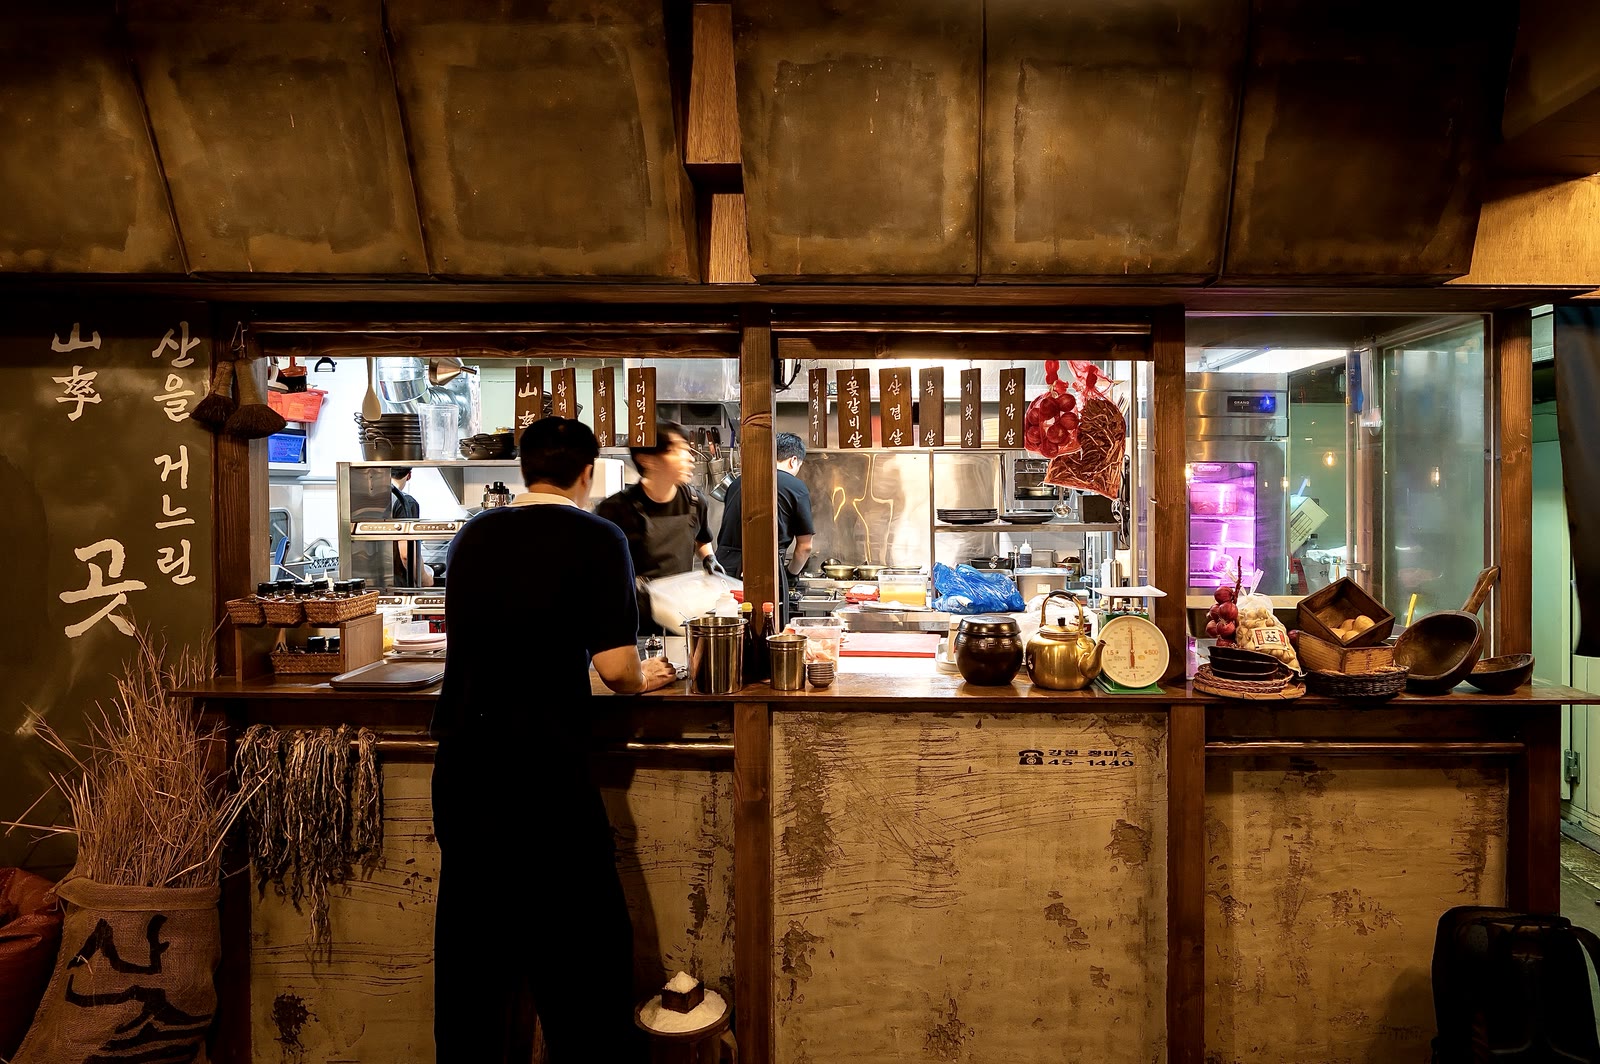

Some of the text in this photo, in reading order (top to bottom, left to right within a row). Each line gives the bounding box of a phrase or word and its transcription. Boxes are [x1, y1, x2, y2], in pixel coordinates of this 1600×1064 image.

[51, 322, 102, 422] 山率
[598, 380, 608, 447] 볶음밥
[635, 381, 646, 447] 더덕구이
[846, 380, 863, 448] 꽃갈비살
[887, 379, 904, 446] 삼겹살
[1004, 378, 1017, 446] 삼각살
[59, 320, 201, 638] 산을 거느린 곳
[1048, 749, 1079, 757] 강원
[1048, 759, 1134, 767] 45-1440
